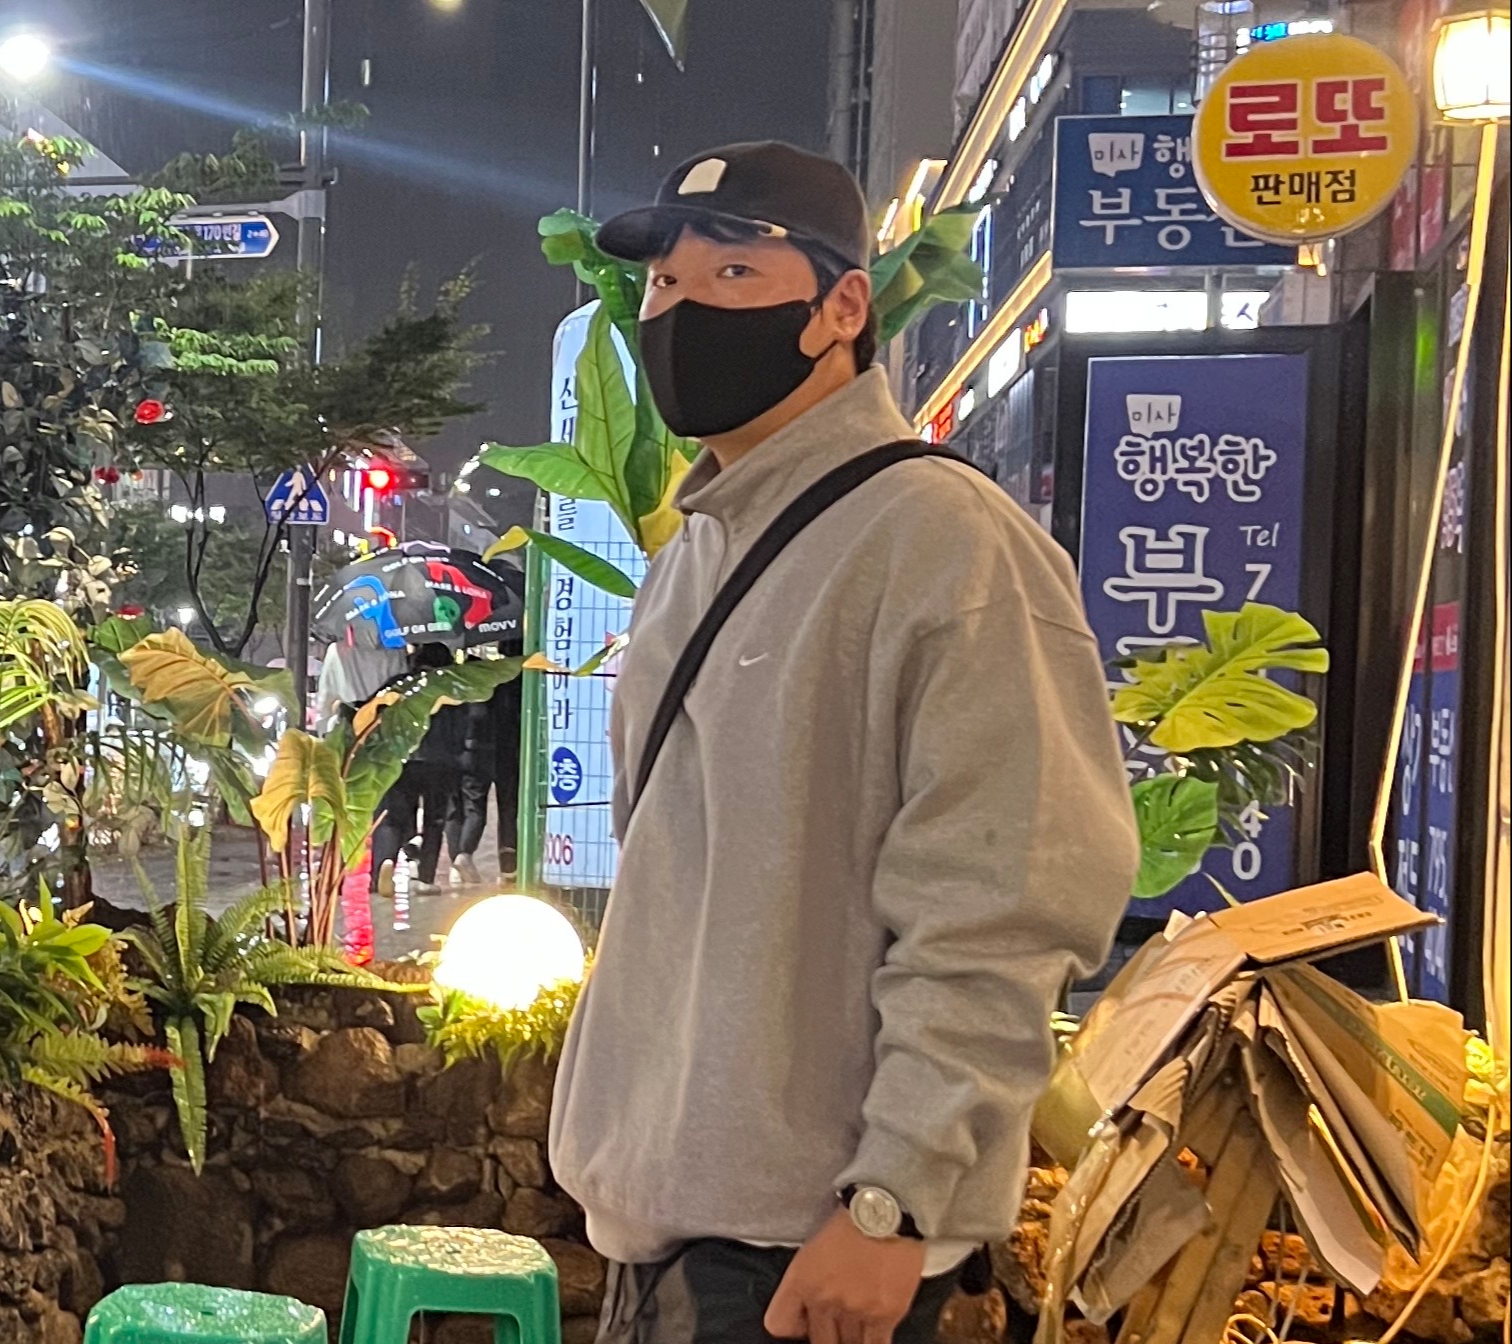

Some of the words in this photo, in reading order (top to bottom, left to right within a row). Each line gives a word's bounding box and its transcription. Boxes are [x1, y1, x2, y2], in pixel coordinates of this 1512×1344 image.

[1224, 76, 1389, 158] 로또
[1094, 140, 1140, 162] 미사
[1250, 169, 1356, 205] 판매점
[1132, 402, 1176, 424] 미사
[1114, 434, 1277, 503] 행복한
[1239, 522, 1280, 547] Tel
